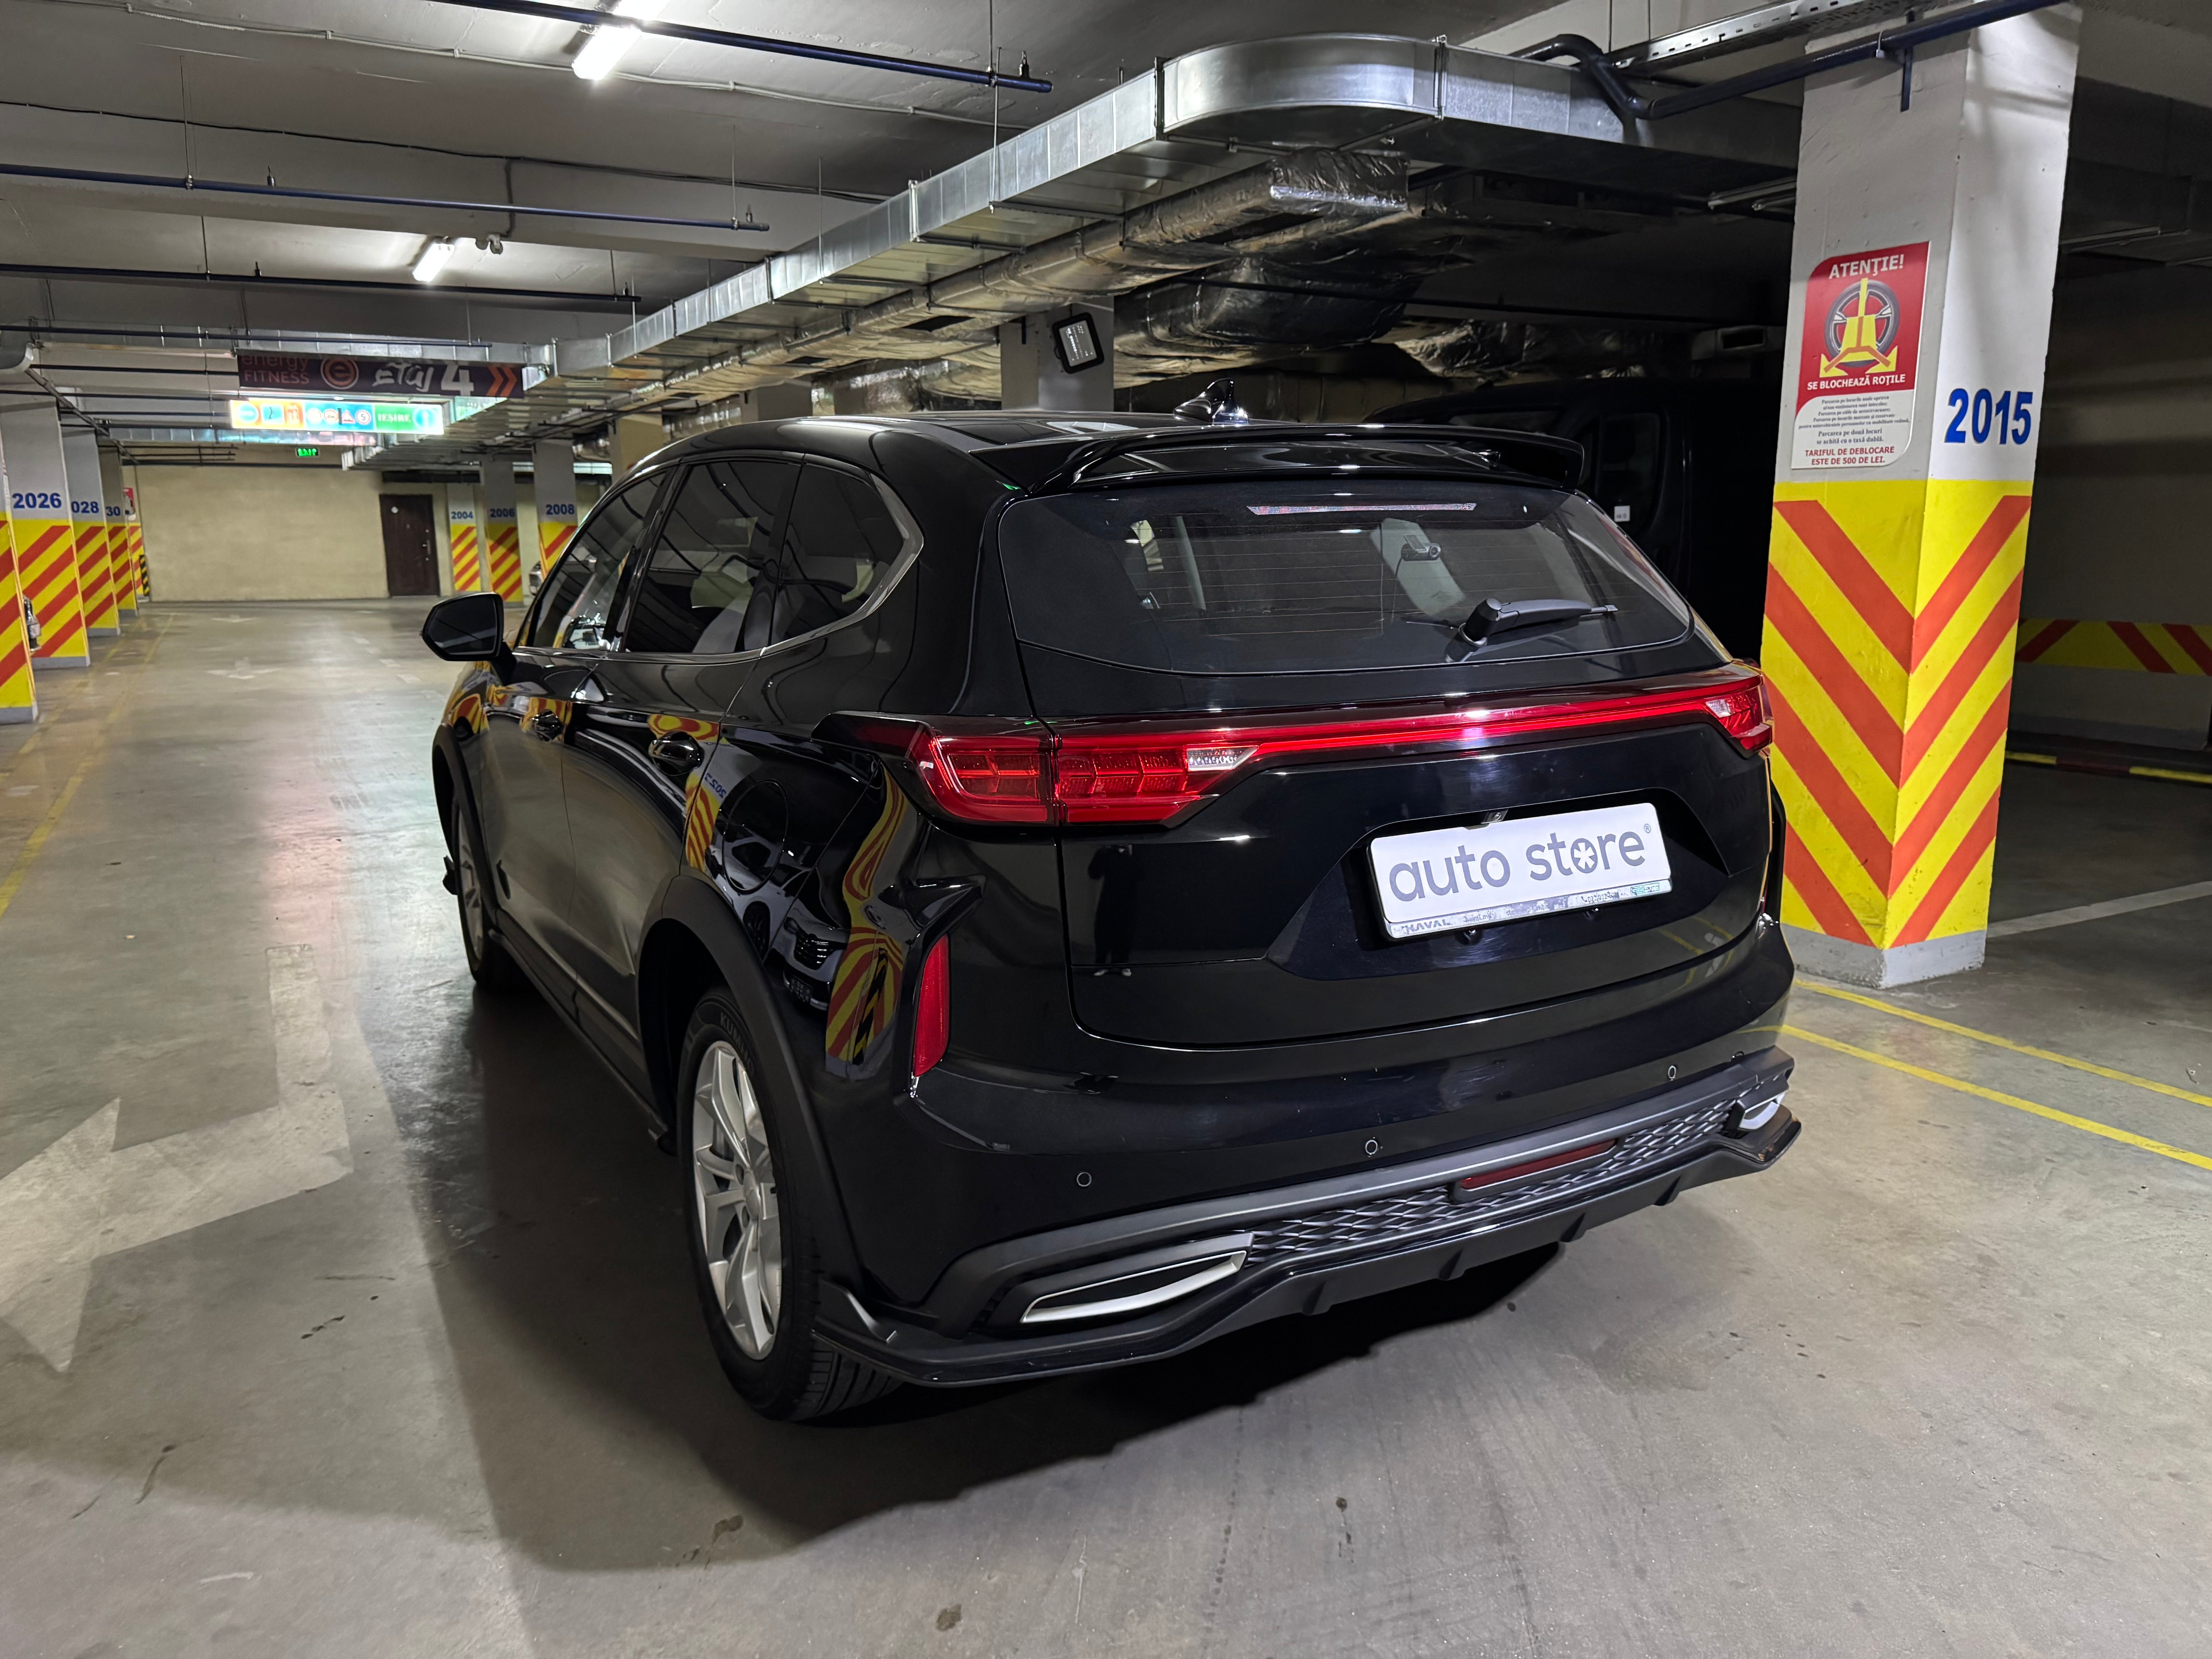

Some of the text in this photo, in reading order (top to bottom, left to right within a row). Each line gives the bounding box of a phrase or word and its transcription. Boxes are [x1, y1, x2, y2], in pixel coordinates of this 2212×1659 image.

[242, 355, 309, 371] energy
[244, 370, 309, 385] FITNESS
[441, 364, 474, 396] 4
[1807, 381, 1818, 390] SE
[1820, 375, 1870, 389] BLOCHEAZĂ
[1944, 388, 2033, 445] 2015
[1850, 446, 1895, 455] DEBLOCARE
[12, 493, 62, 509] 2026
[71, 501, 99, 514] 028
[105, 506, 120, 516] 30
[451, 511, 474, 519] 2004
[490, 508, 515, 518] 2006
[546, 504, 575, 515] 2008
[1389, 845, 1511, 902] auto
[1405, 919, 1451, 934] HAVAL
